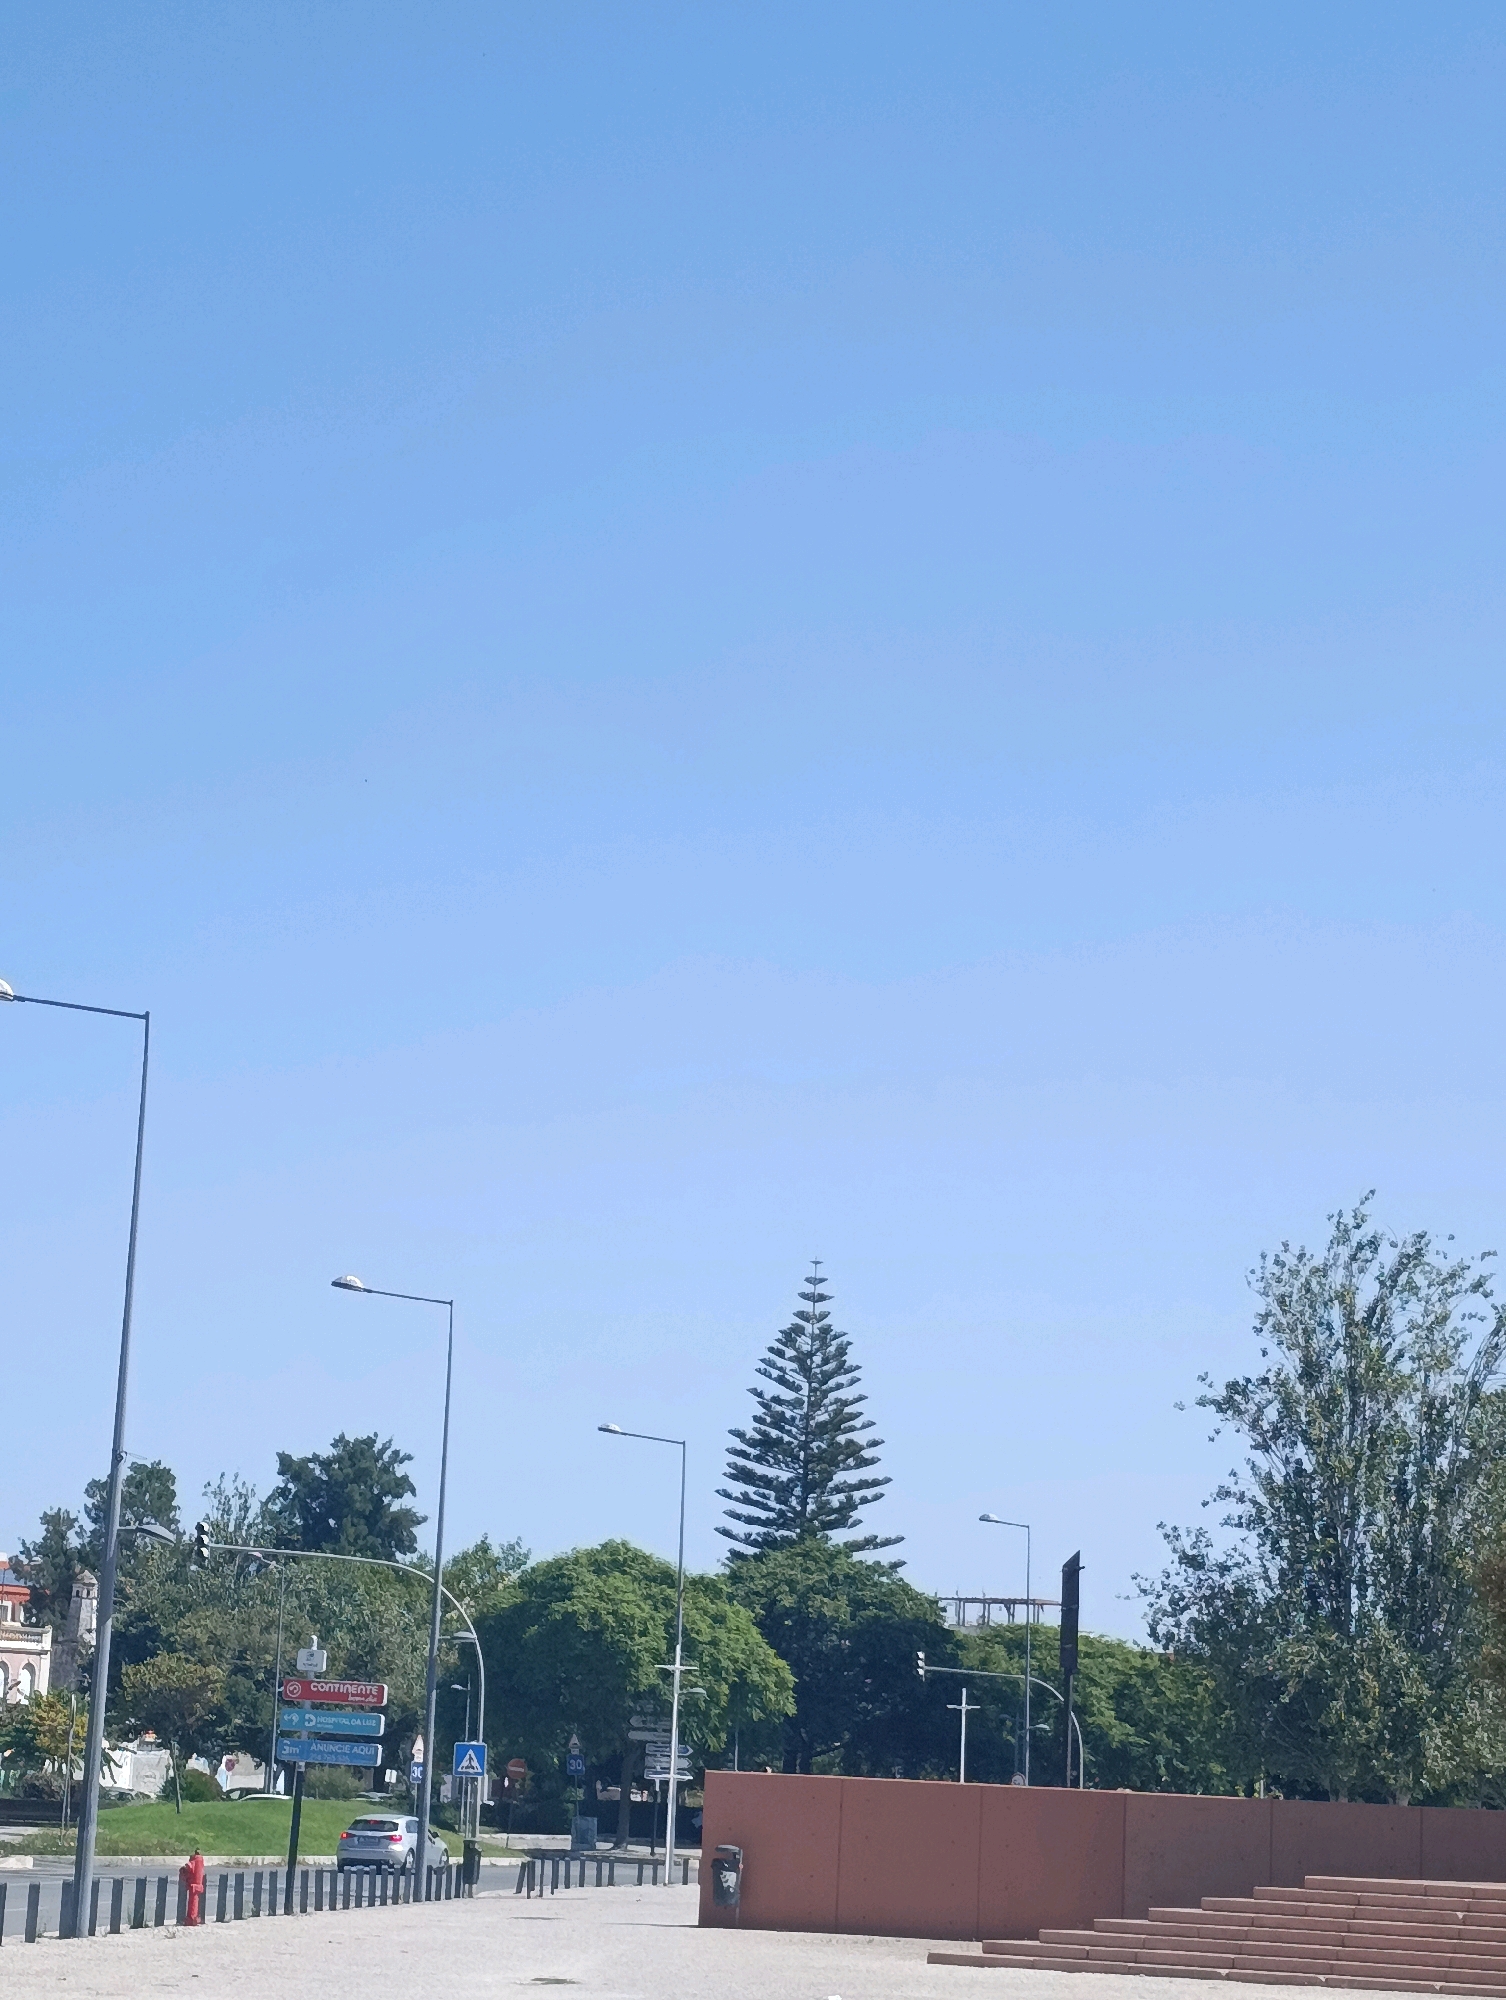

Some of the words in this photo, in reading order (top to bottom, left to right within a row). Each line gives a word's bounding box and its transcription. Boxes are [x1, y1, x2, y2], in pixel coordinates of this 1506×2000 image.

[310, 1682, 378, 1695] CONTINENTE
[317, 1715, 350, 1725] HOSPITAL
[362, 1718, 377, 1727] LUZ
[310, 1742, 350, 1754] ANUNCIE
[352, 1745, 375, 1755] AQUI
[570, 1759, 583, 1770] 30
